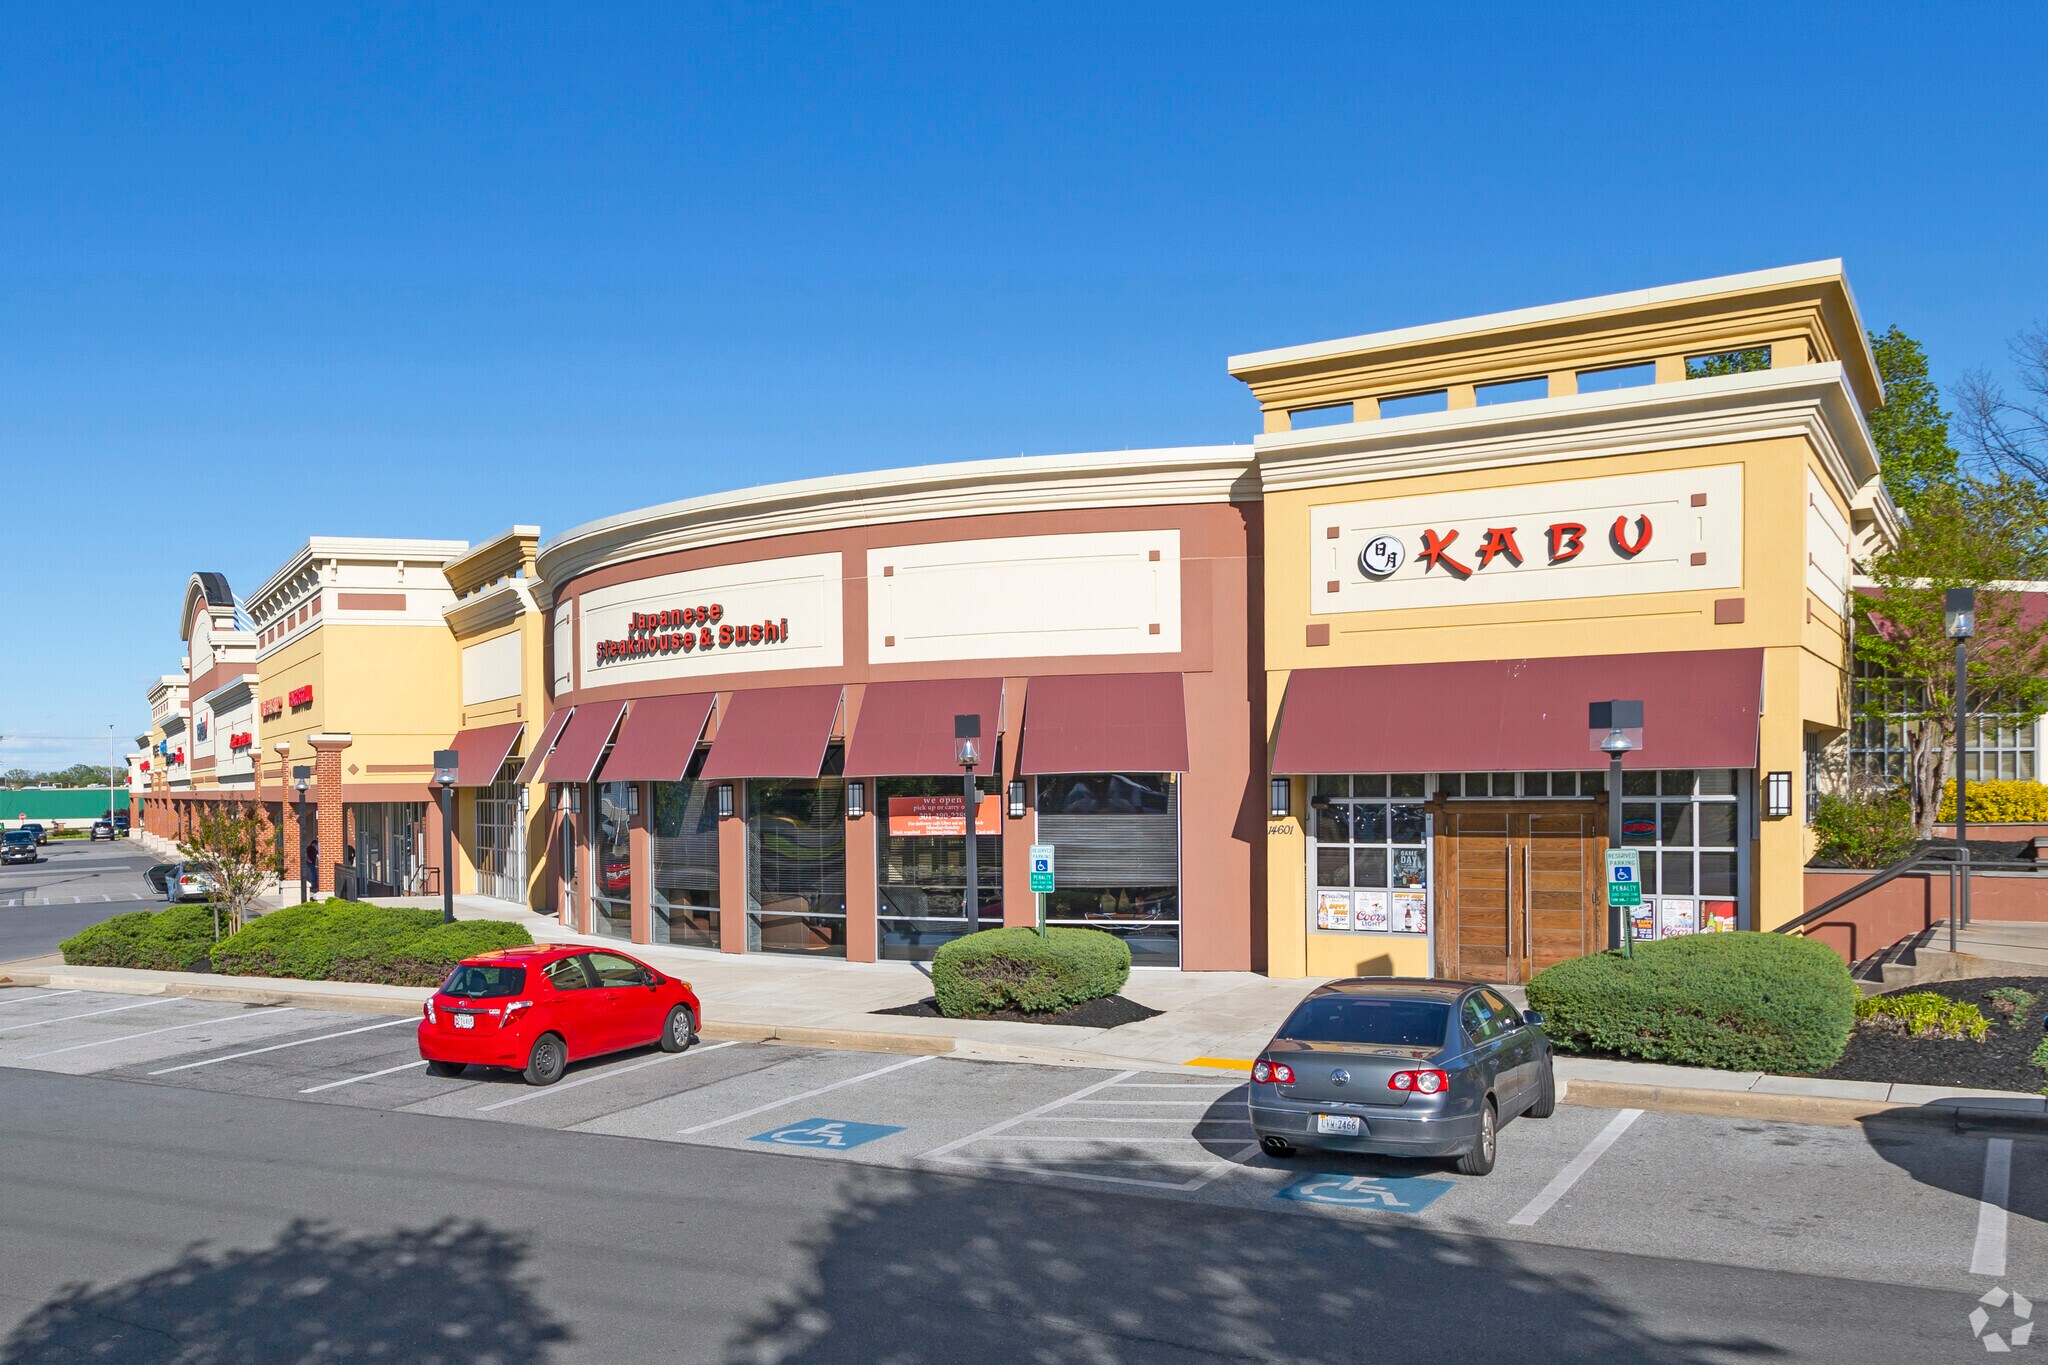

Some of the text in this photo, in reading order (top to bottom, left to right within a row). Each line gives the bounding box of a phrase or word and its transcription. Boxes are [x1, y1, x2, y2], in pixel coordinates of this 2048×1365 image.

[1418, 513, 1653, 577] KABU
[628, 603, 724, 633] Japanese
[596, 617, 789, 662] Steakhouse & Sushi
[939, 797, 962, 805] open
[1268, 825, 1294, 835] 14601
[1400, 856, 1418, 864] DAY
[1356, 910, 1387, 922] Coors
